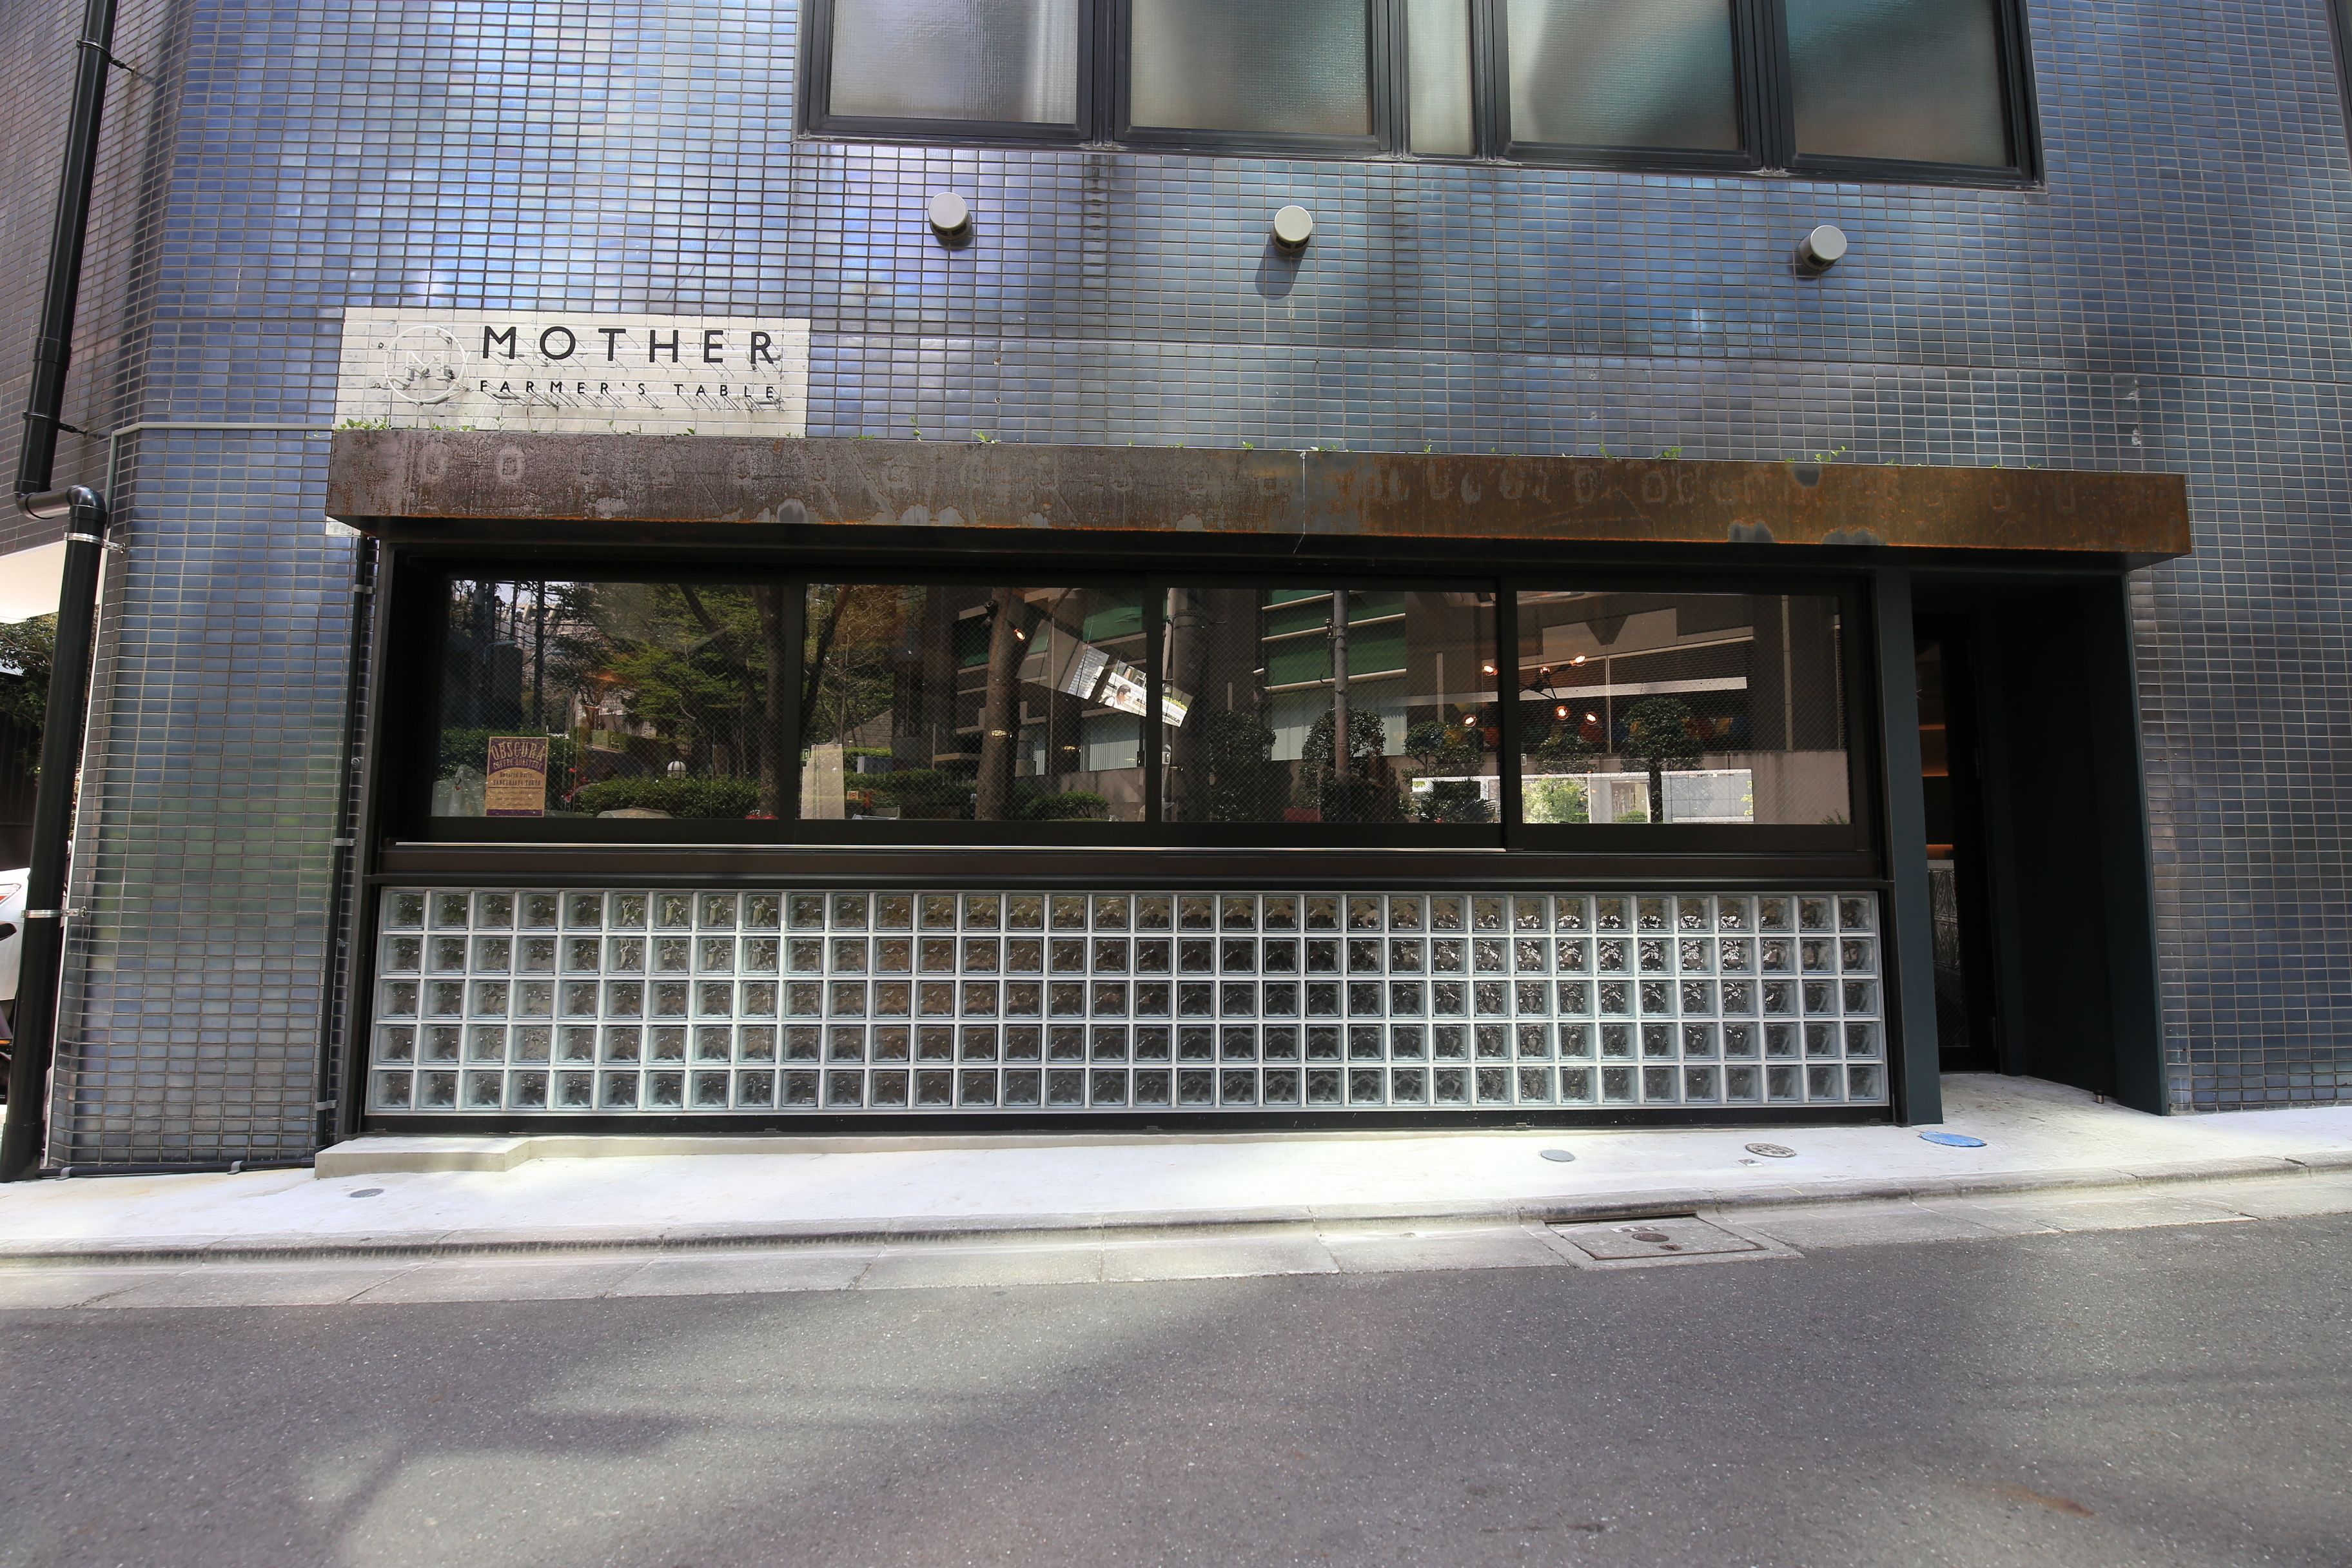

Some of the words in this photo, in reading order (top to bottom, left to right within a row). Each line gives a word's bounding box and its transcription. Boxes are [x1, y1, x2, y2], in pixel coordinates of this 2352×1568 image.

[482, 326, 774, 364] MOTHER
[480, 380, 645, 395] FARMER'S
[674, 384, 774, 398] TABLE
[491, 741, 544, 761] OBSCURA
[493, 758, 514, 770] COFFEE
[515, 758, 543, 770] ROASTERS
